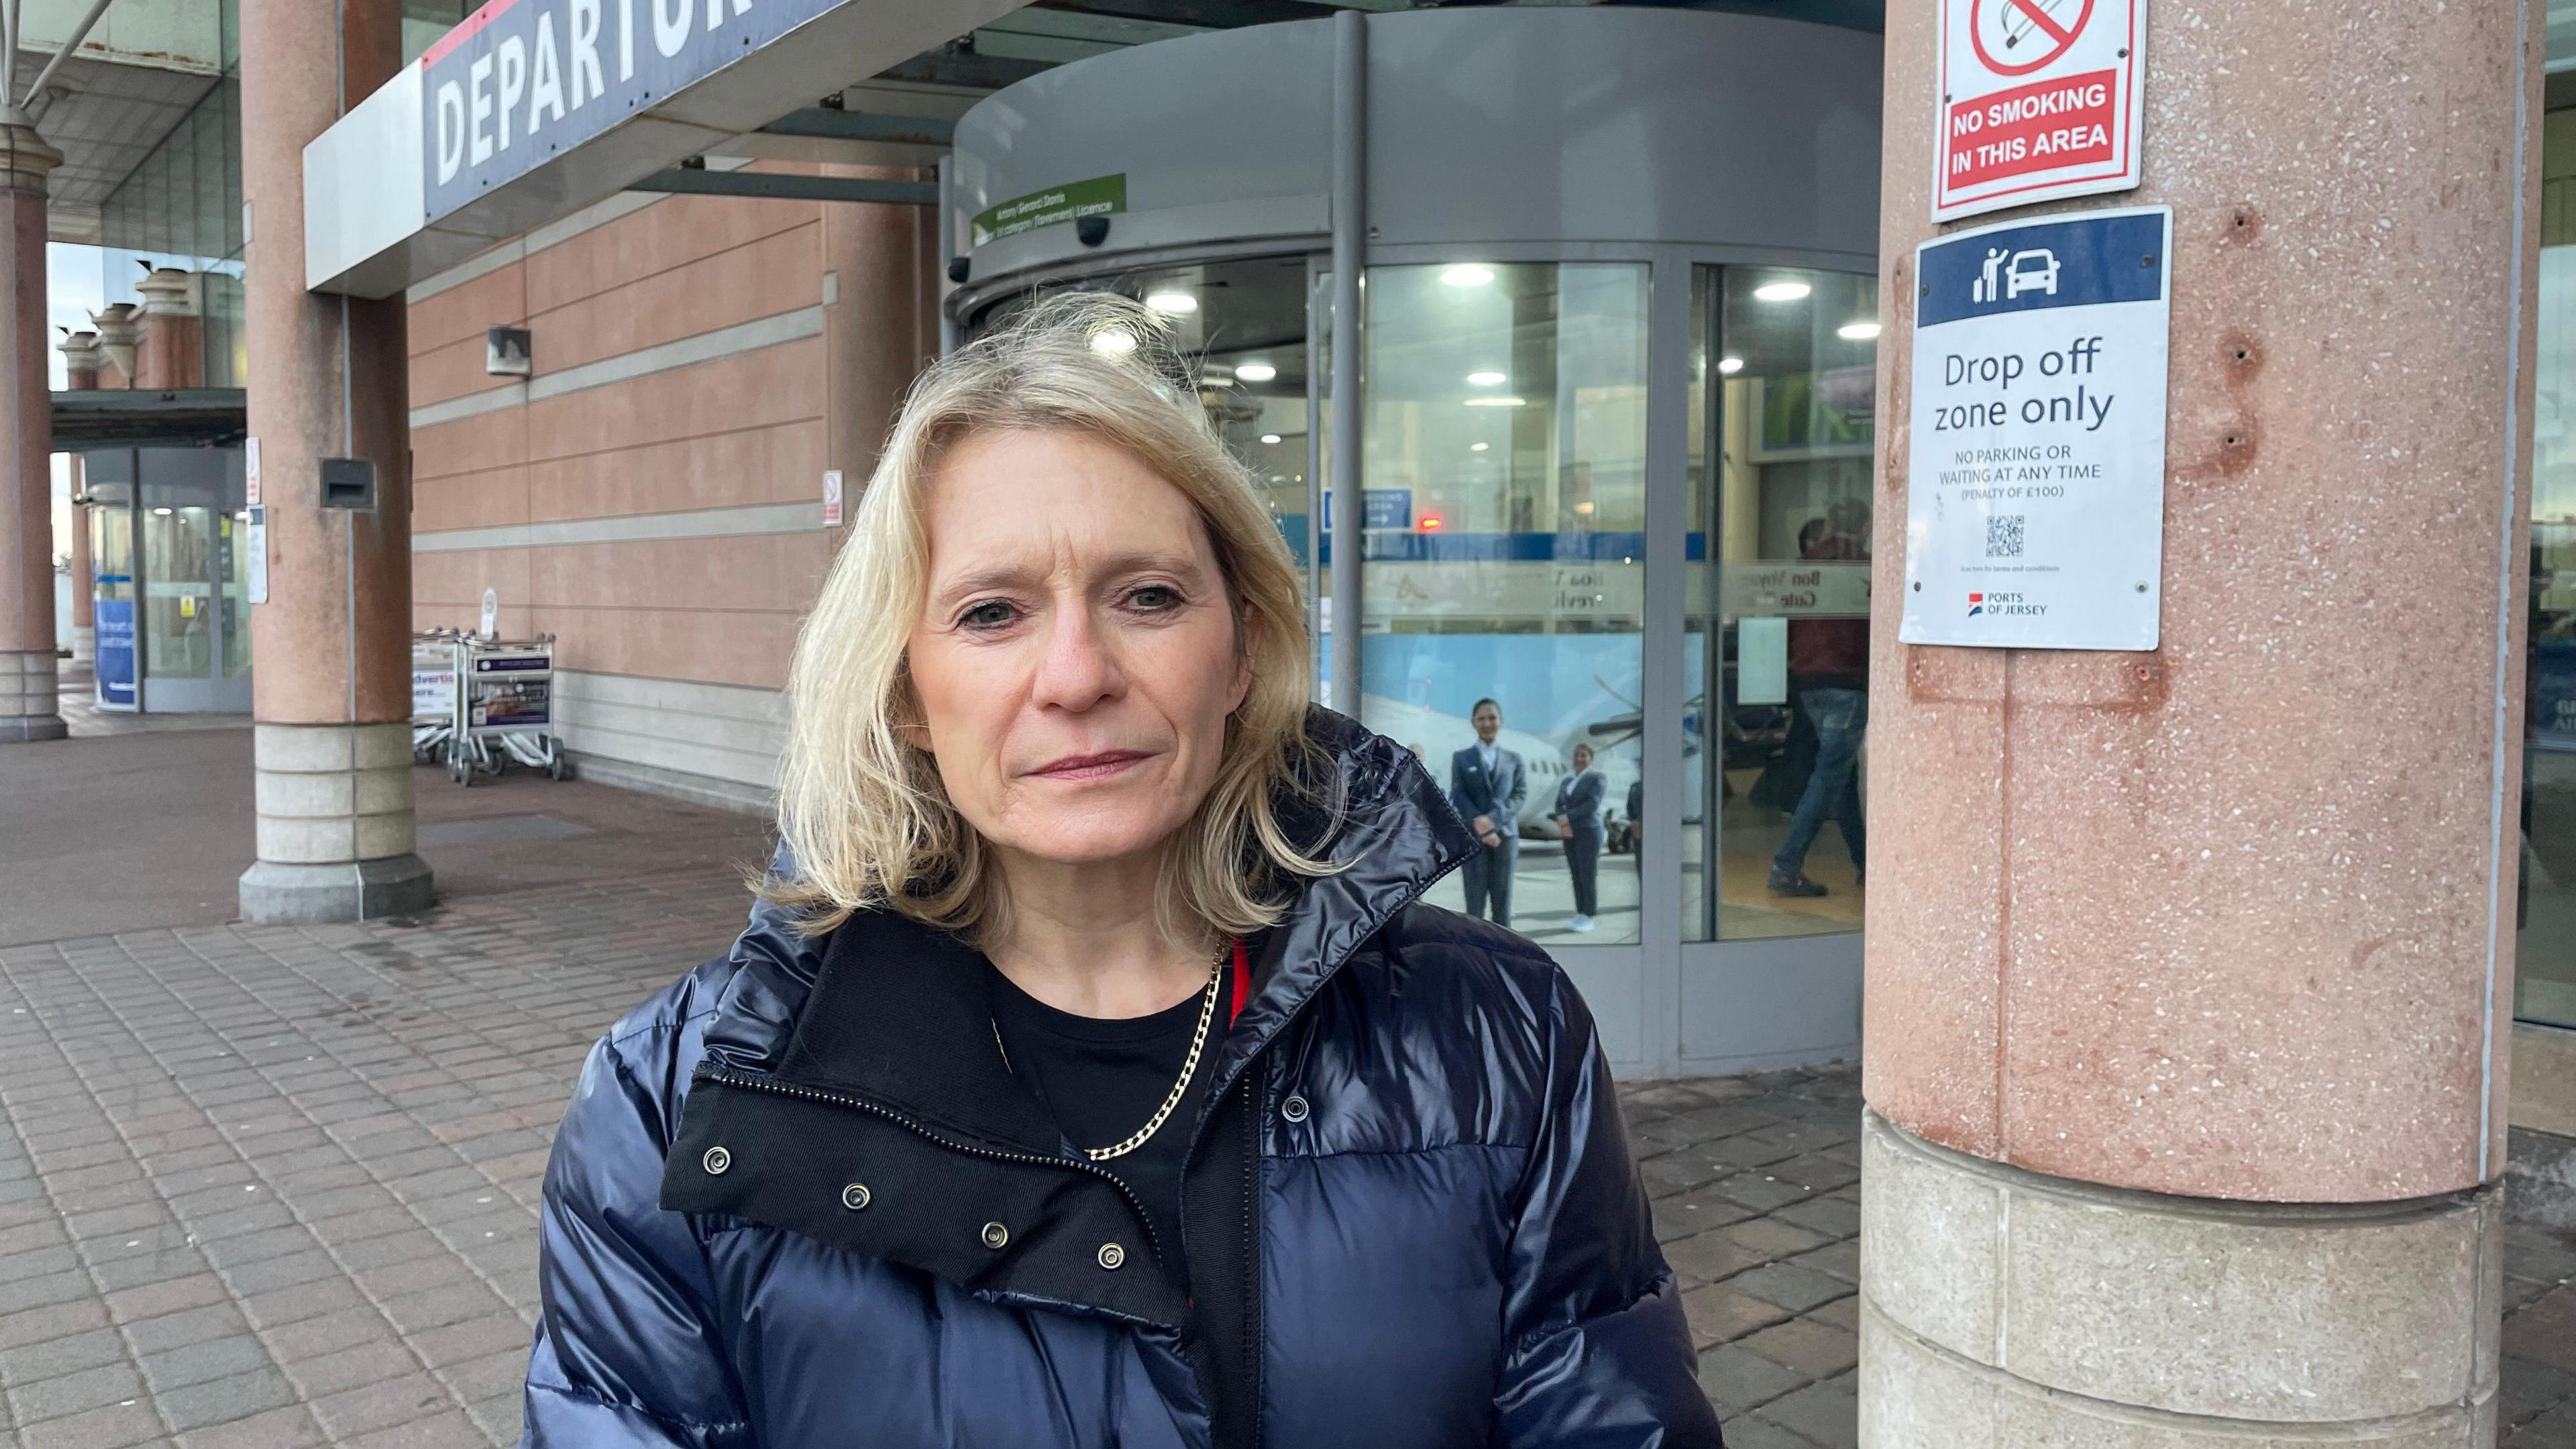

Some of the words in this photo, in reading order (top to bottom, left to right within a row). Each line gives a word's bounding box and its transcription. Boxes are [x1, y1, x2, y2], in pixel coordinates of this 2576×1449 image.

[1953, 110, 1983, 138] NO
[1988, 84, 2106, 127] SMOKING
[1952, 150, 1972, 174] IN
[1976, 138, 2027, 168] THIS
[2032, 123, 2108, 157] AREA
[1077, 201, 1113, 216] Licence
[1946, 354, 2024, 390] Drop
[2039, 336, 2103, 376] off
[1935, 400, 2007, 431] zone
[2021, 384, 2114, 431] only
[1955, 450, 1974, 465] NO
[1977, 445, 2041, 464] PARKING
[2047, 445, 2072, 460] OR
[1939, 468, 1991, 486] WAITING
[1994, 467, 2013, 482] AT
[2017, 465, 2053, 481] ANY
[2057, 464, 2102, 479] TIME
[1961, 488, 2004, 501] (PENALTY
[2007, 486, 2023, 498] OF
[2027, 485, 2065, 498] £100)
[1988, 592, 2023, 602] PORTS
[1988, 605, 2002, 614] OF
[2004, 605, 2047, 615] JERSEY
